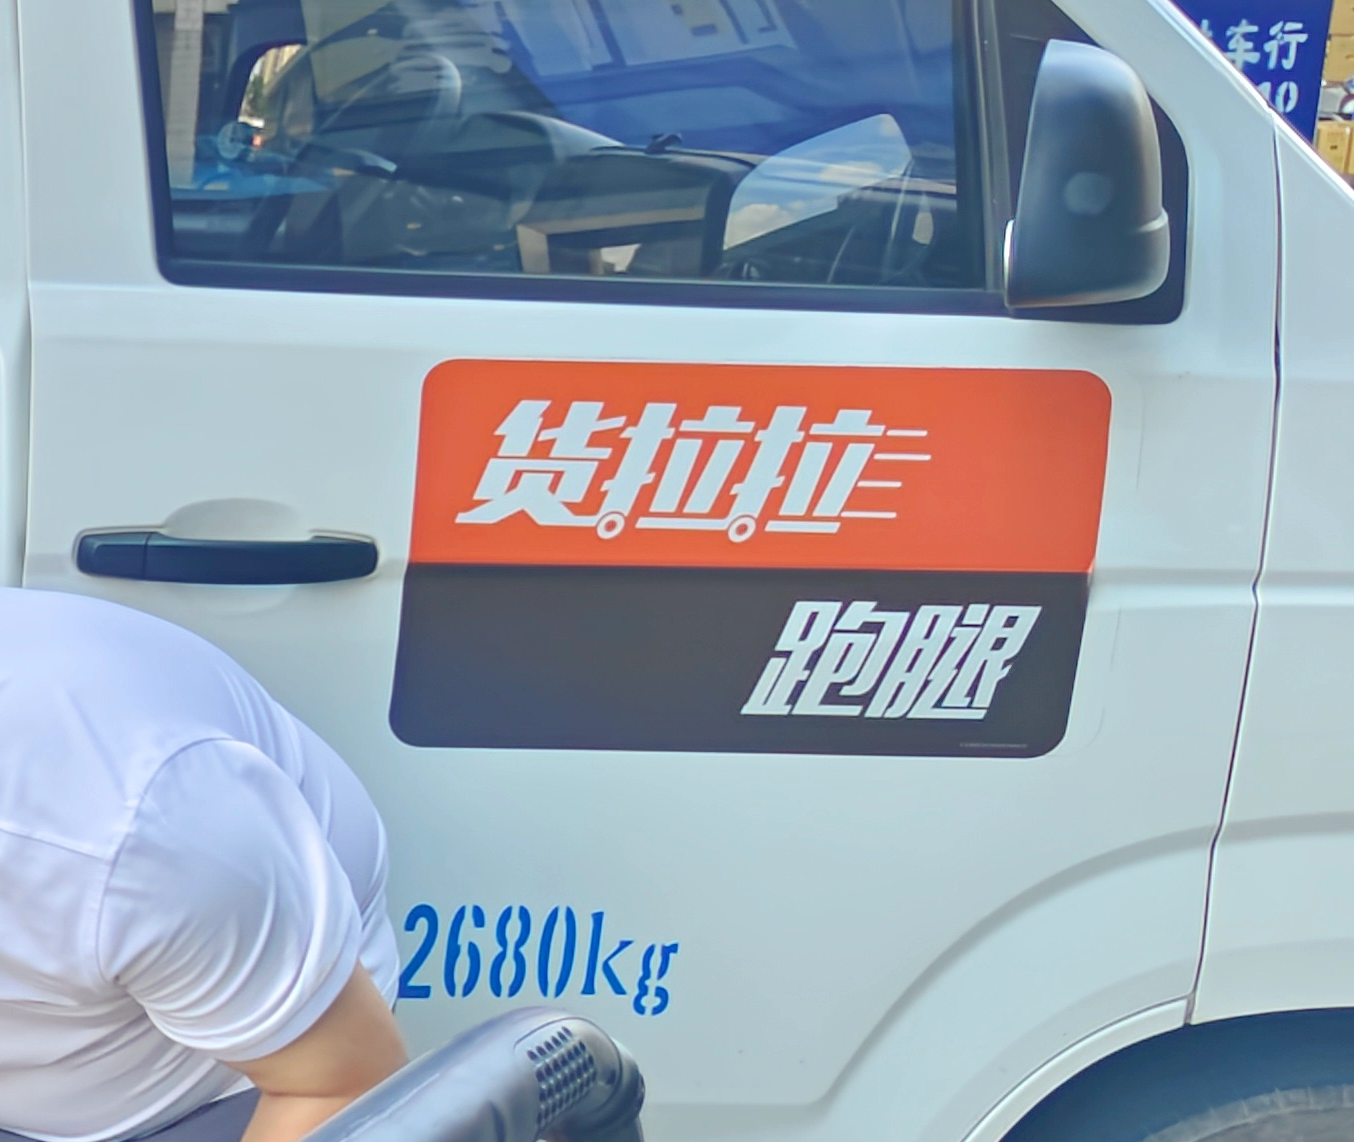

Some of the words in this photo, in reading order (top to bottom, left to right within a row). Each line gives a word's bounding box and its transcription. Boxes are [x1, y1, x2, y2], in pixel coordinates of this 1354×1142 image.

[1200, 19, 1308, 70] 车行
[454, 400, 886, 542] 货拉拉
[740, 601, 1042, 720] 跑腿
[397, 904, 679, 1016] 2680kg
